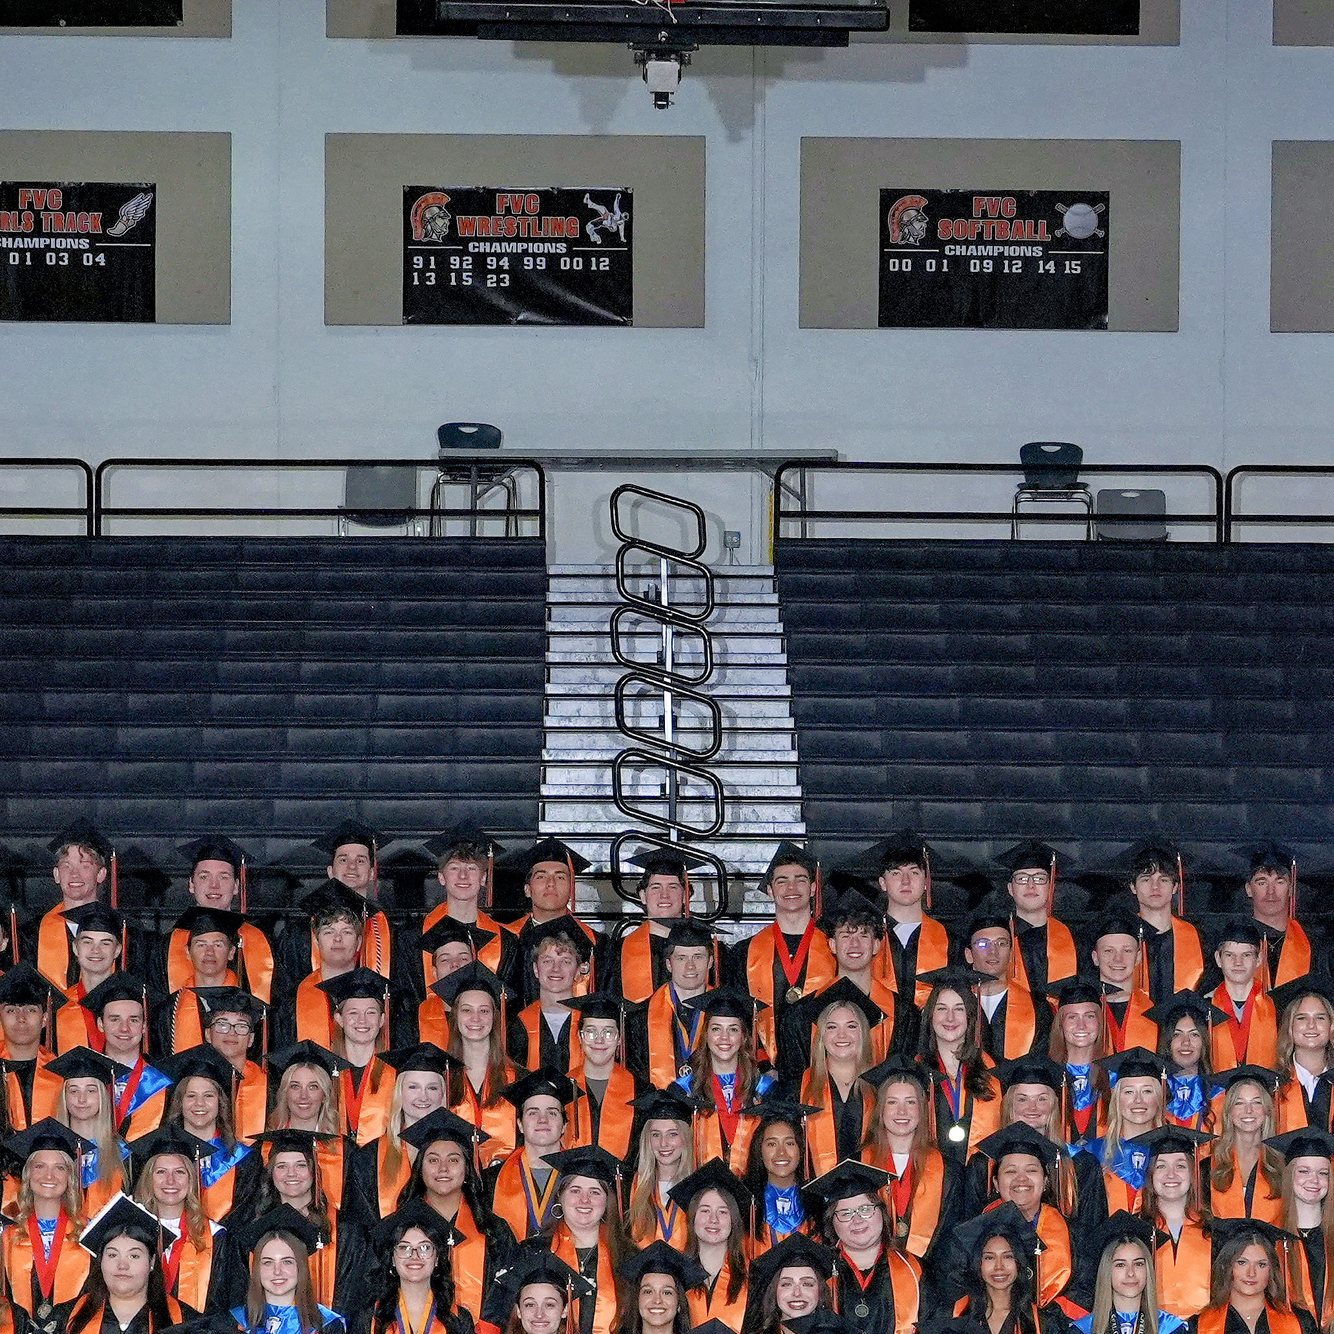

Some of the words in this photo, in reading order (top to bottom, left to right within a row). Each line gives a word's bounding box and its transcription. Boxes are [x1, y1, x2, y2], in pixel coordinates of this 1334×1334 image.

[19, 189, 62, 210] FVC
[496, 193, 539, 214] FVC
[973, 197, 1016, 218] FVC
[41, 212, 102, 233] TRACK
[456, 216, 579, 238] WRESTLING
[938, 219, 1051, 241] SOFTBALL
[468, 242, 566, 254] CHAMPIONS
[945, 245, 1042, 257] CHAMPIONS
[10, 252, 32, 265] 01
[46, 252, 69, 265] 03
[83, 253, 105, 266] 04
[413, 256, 436, 269] 91
[450, 256, 472, 269] 92
[487, 257, 509, 269] 94
[524, 257, 547, 270] 99
[560, 257, 582, 270] 00
[591, 257, 609, 270] 12
[889, 259, 911, 272] 00
[926, 259, 948, 272] 01
[970, 259, 993, 273] 09
[1003, 260, 1022, 273] 12
[1038, 260, 1055, 273] 14
[1064, 260, 1081, 273] 15
[413, 273, 435, 285] 13
[450, 273, 472, 286] 15
[487, 274, 510, 287] 23
